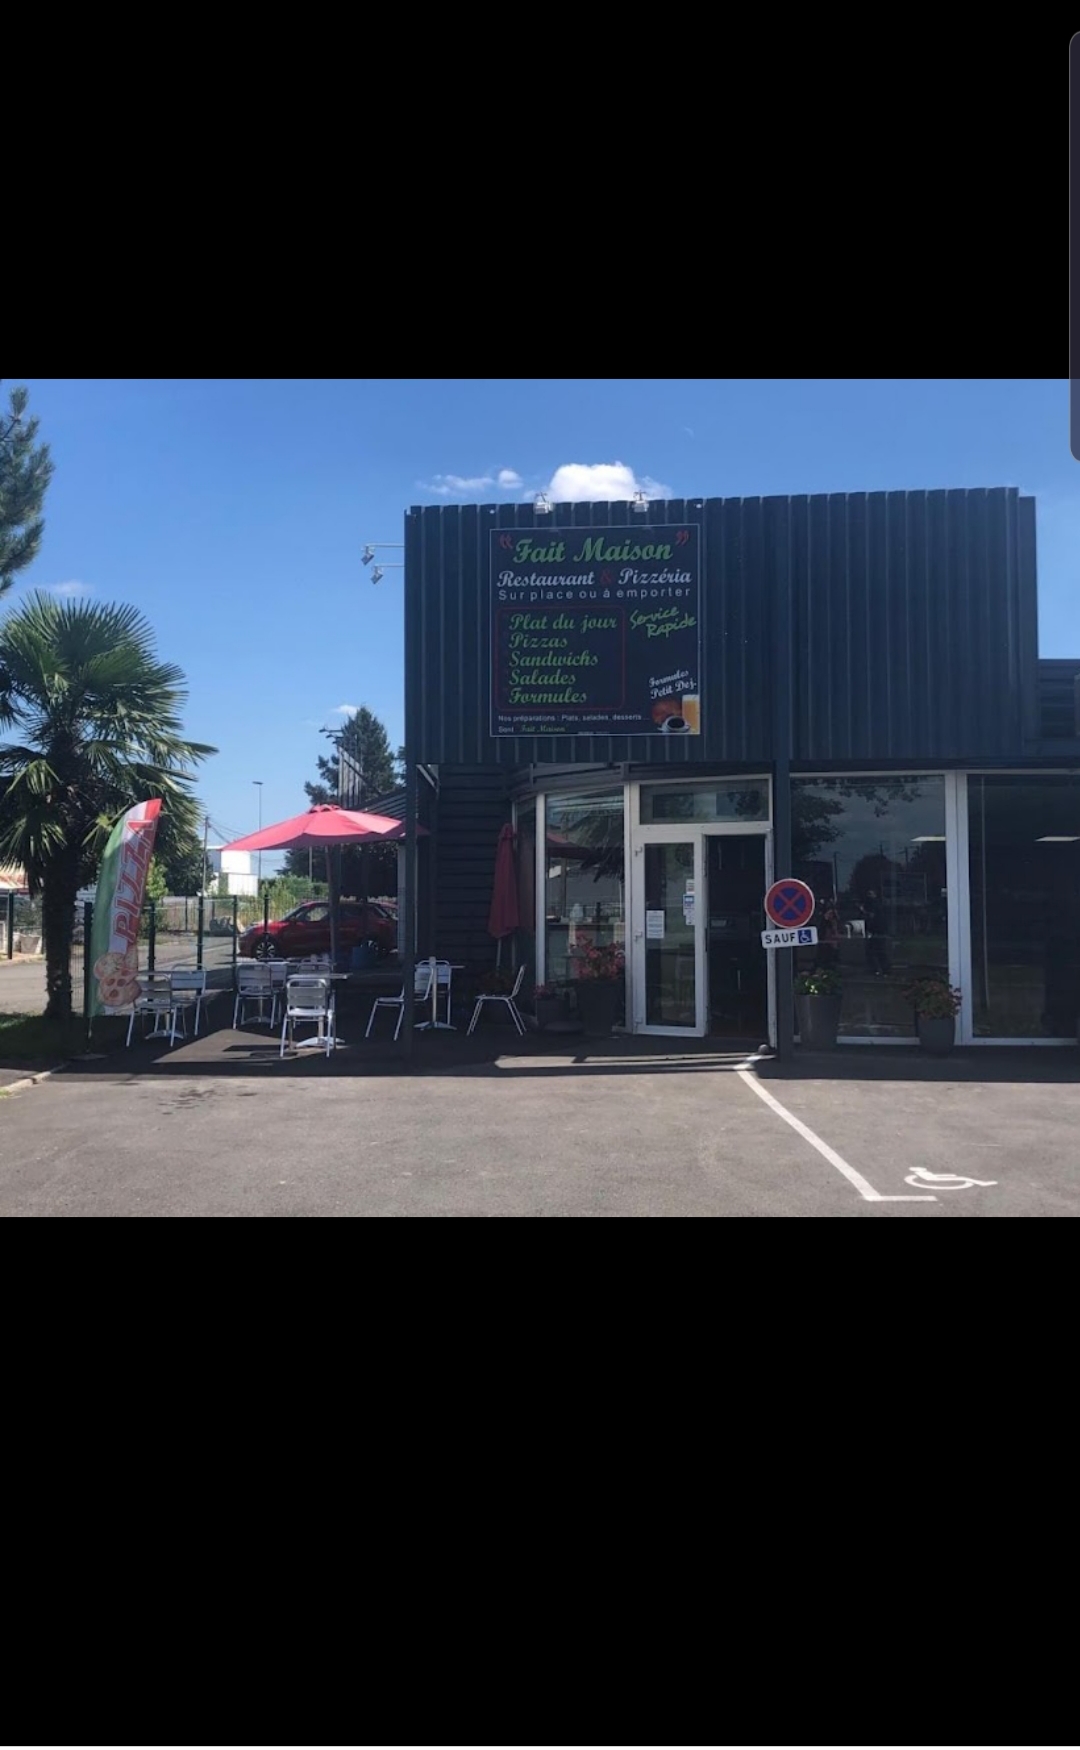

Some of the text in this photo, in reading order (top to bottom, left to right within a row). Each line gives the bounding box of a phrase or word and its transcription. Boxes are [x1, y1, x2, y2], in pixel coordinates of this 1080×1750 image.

[496, 567, 693, 587] Restaurant & Pizzéria
[498, 587, 691, 602] Sur place ou à emporter
[508, 613, 618, 634] Plat du jour
[629, 606, 680, 630] Service
[646, 613, 697, 638] Rapide
[508, 632, 568, 648] Pizzas
[508, 650, 599, 667] Sandwichs
[508, 668, 576, 685] Salades
[649, 669, 690, 688] Formules
[508, 687, 588, 704] Formules
[650, 684, 674, 700] Petit
[513, 714, 555, 723] préparations
[113, 820, 155, 943] PIZZA
[765, 932, 796, 944] SAUF
